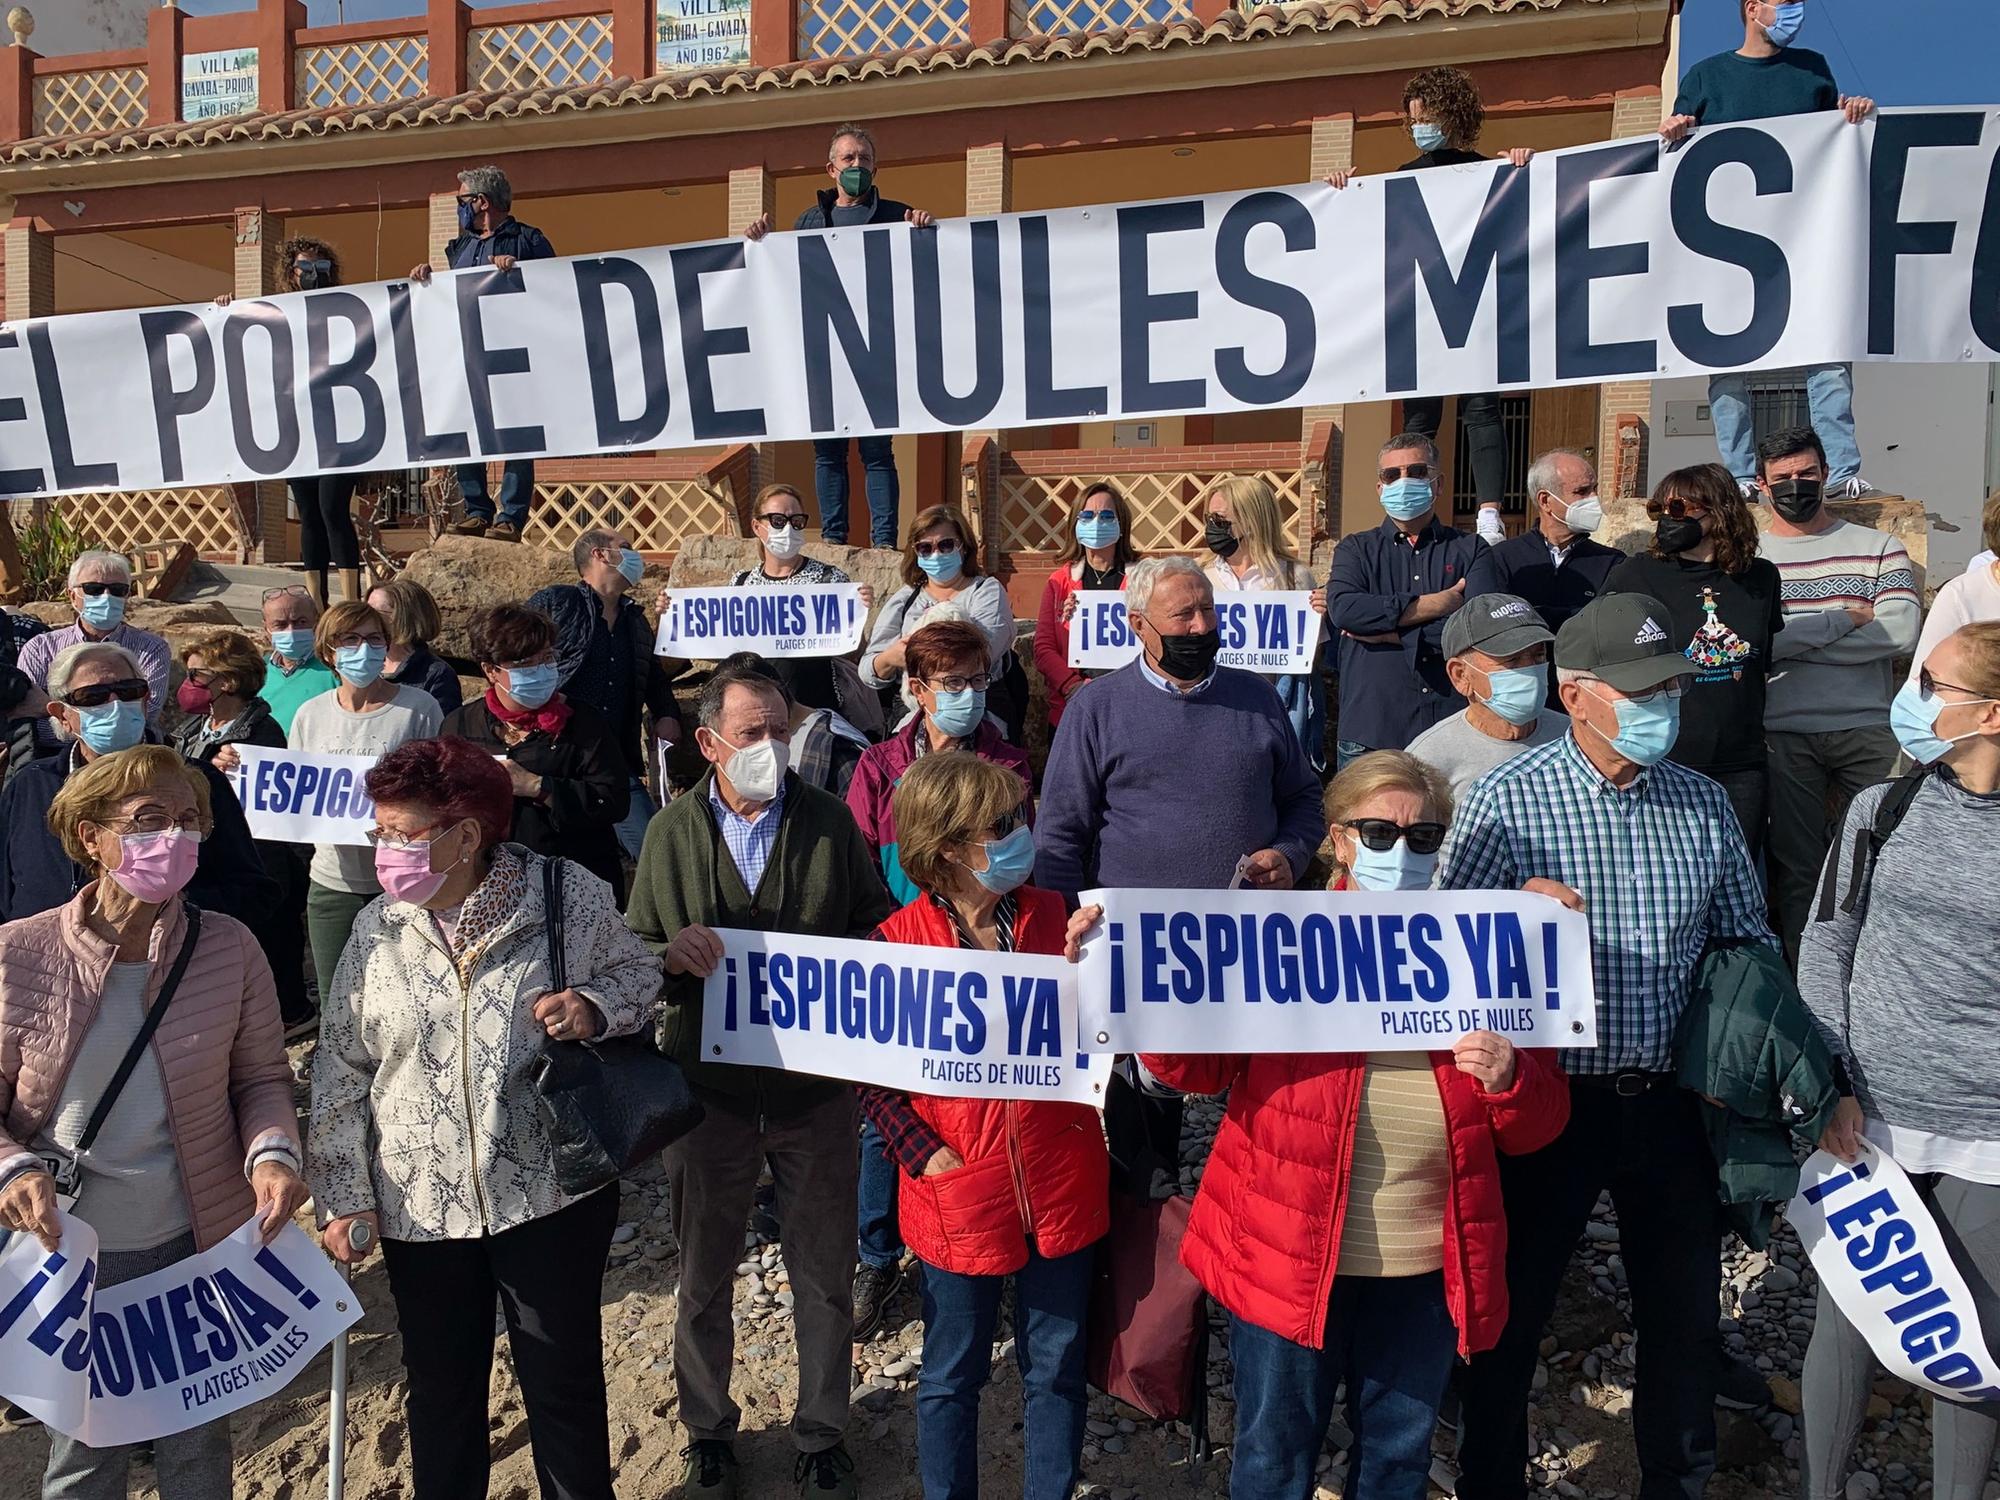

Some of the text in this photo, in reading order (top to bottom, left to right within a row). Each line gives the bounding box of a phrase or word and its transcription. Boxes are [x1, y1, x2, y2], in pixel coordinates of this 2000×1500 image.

[681, 0, 728, 16] VILLA
[201, 56, 240, 74] VILLA
[676, 46, 730, 64] AÑO 1962
[220, 102, 242, 116] 1962
[139, 267, 547, 483] POBLE
[571, 242, 766, 448] DE
[797, 191, 1316, 433] NULES
[684, 594, 805, 638] ESPIGONES
[811, 594, 841, 634] YA
[1254, 604, 1289, 649] YA
[775, 638, 805, 650] PLATGES
[808, 638, 817, 649] DE
[1634, 632, 1667, 644] adidas
[1217, 652, 1289, 666] ATGES DE NULES
[1140, 911, 1449, 1004] ESPIGONES
[1455, 911, 1532, 999] YA
[747, 952, 988, 1055] ESPIGONES
[1001, 975, 1062, 1057] YA
[1381, 1008, 1534, 1034] PLATGES DE NULES
[921, 1058, 1061, 1087] PLATGES DE NULES
[181, 1364, 249, 1410] PLATGES
[256, 1325, 309, 1377] NULES
